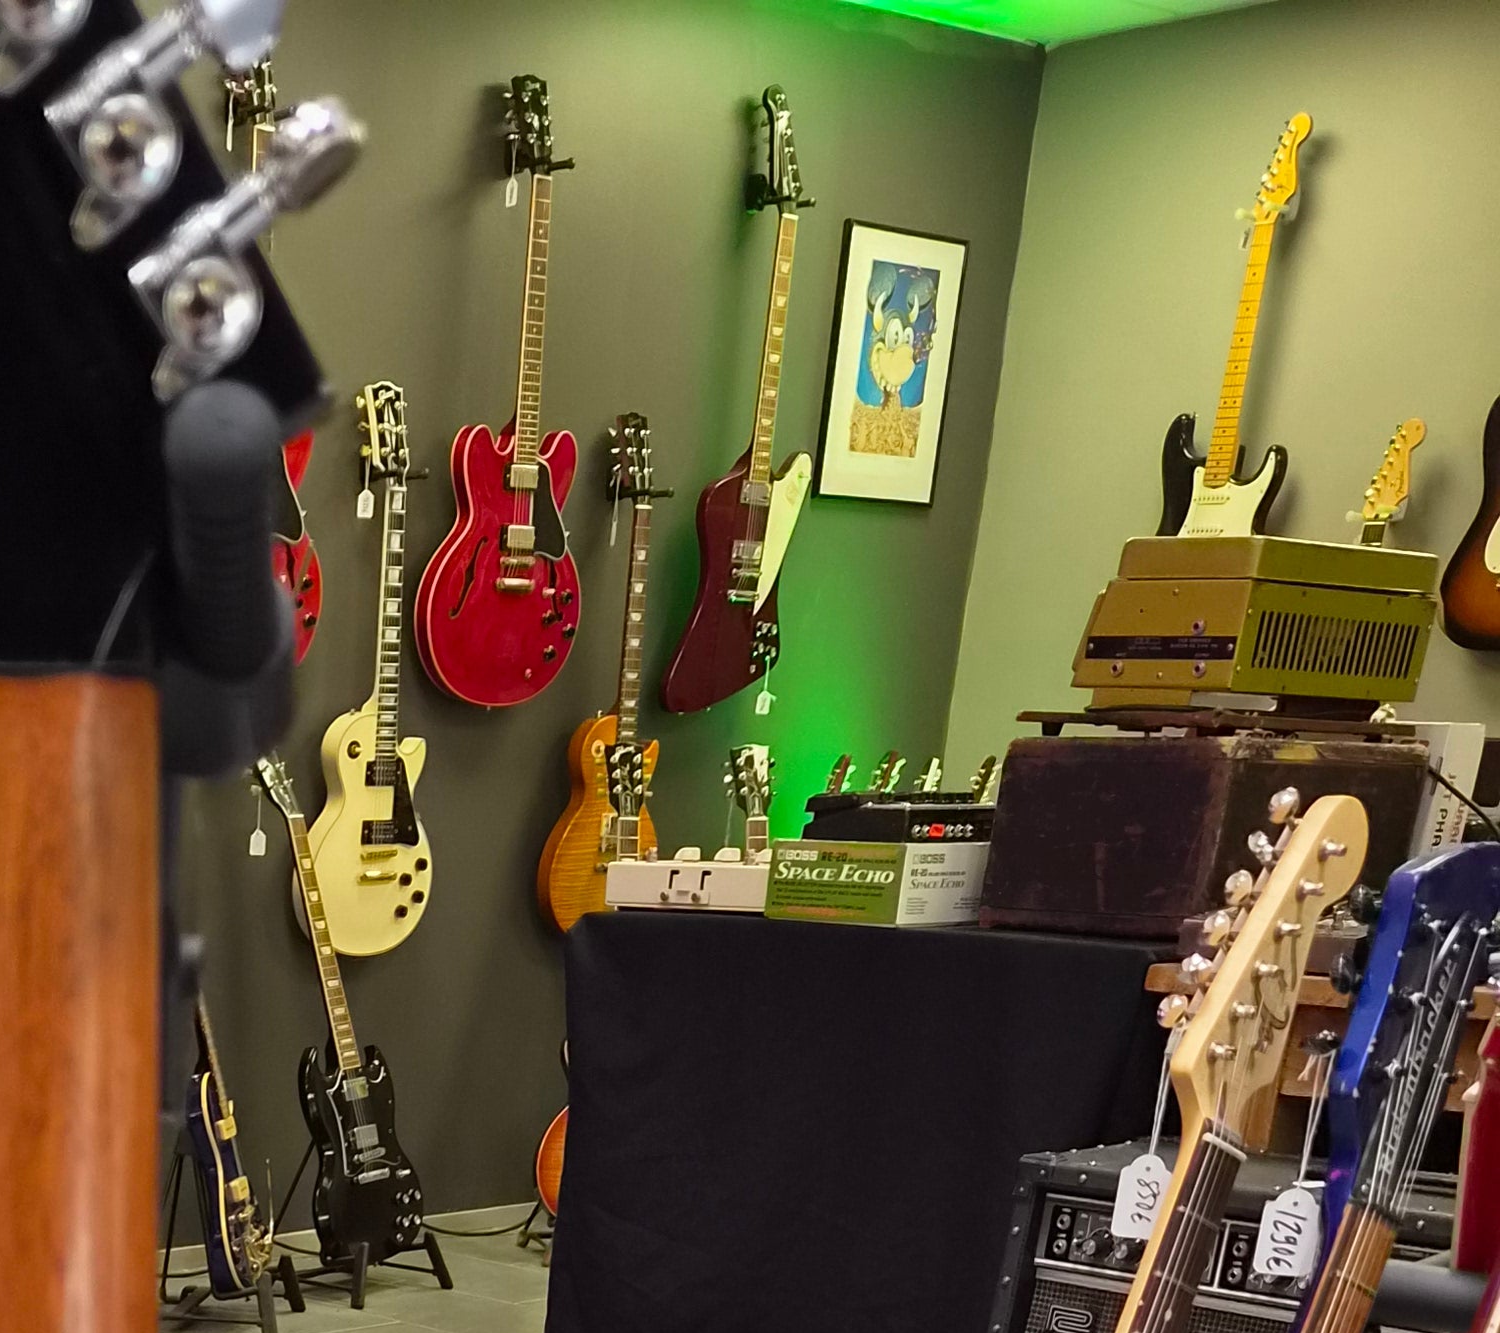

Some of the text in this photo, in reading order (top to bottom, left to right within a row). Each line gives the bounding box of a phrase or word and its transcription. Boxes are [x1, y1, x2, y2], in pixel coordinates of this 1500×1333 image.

[774, 861, 895, 884] SPACE ECHO
[1266, 1209, 1308, 1271] 1290€
